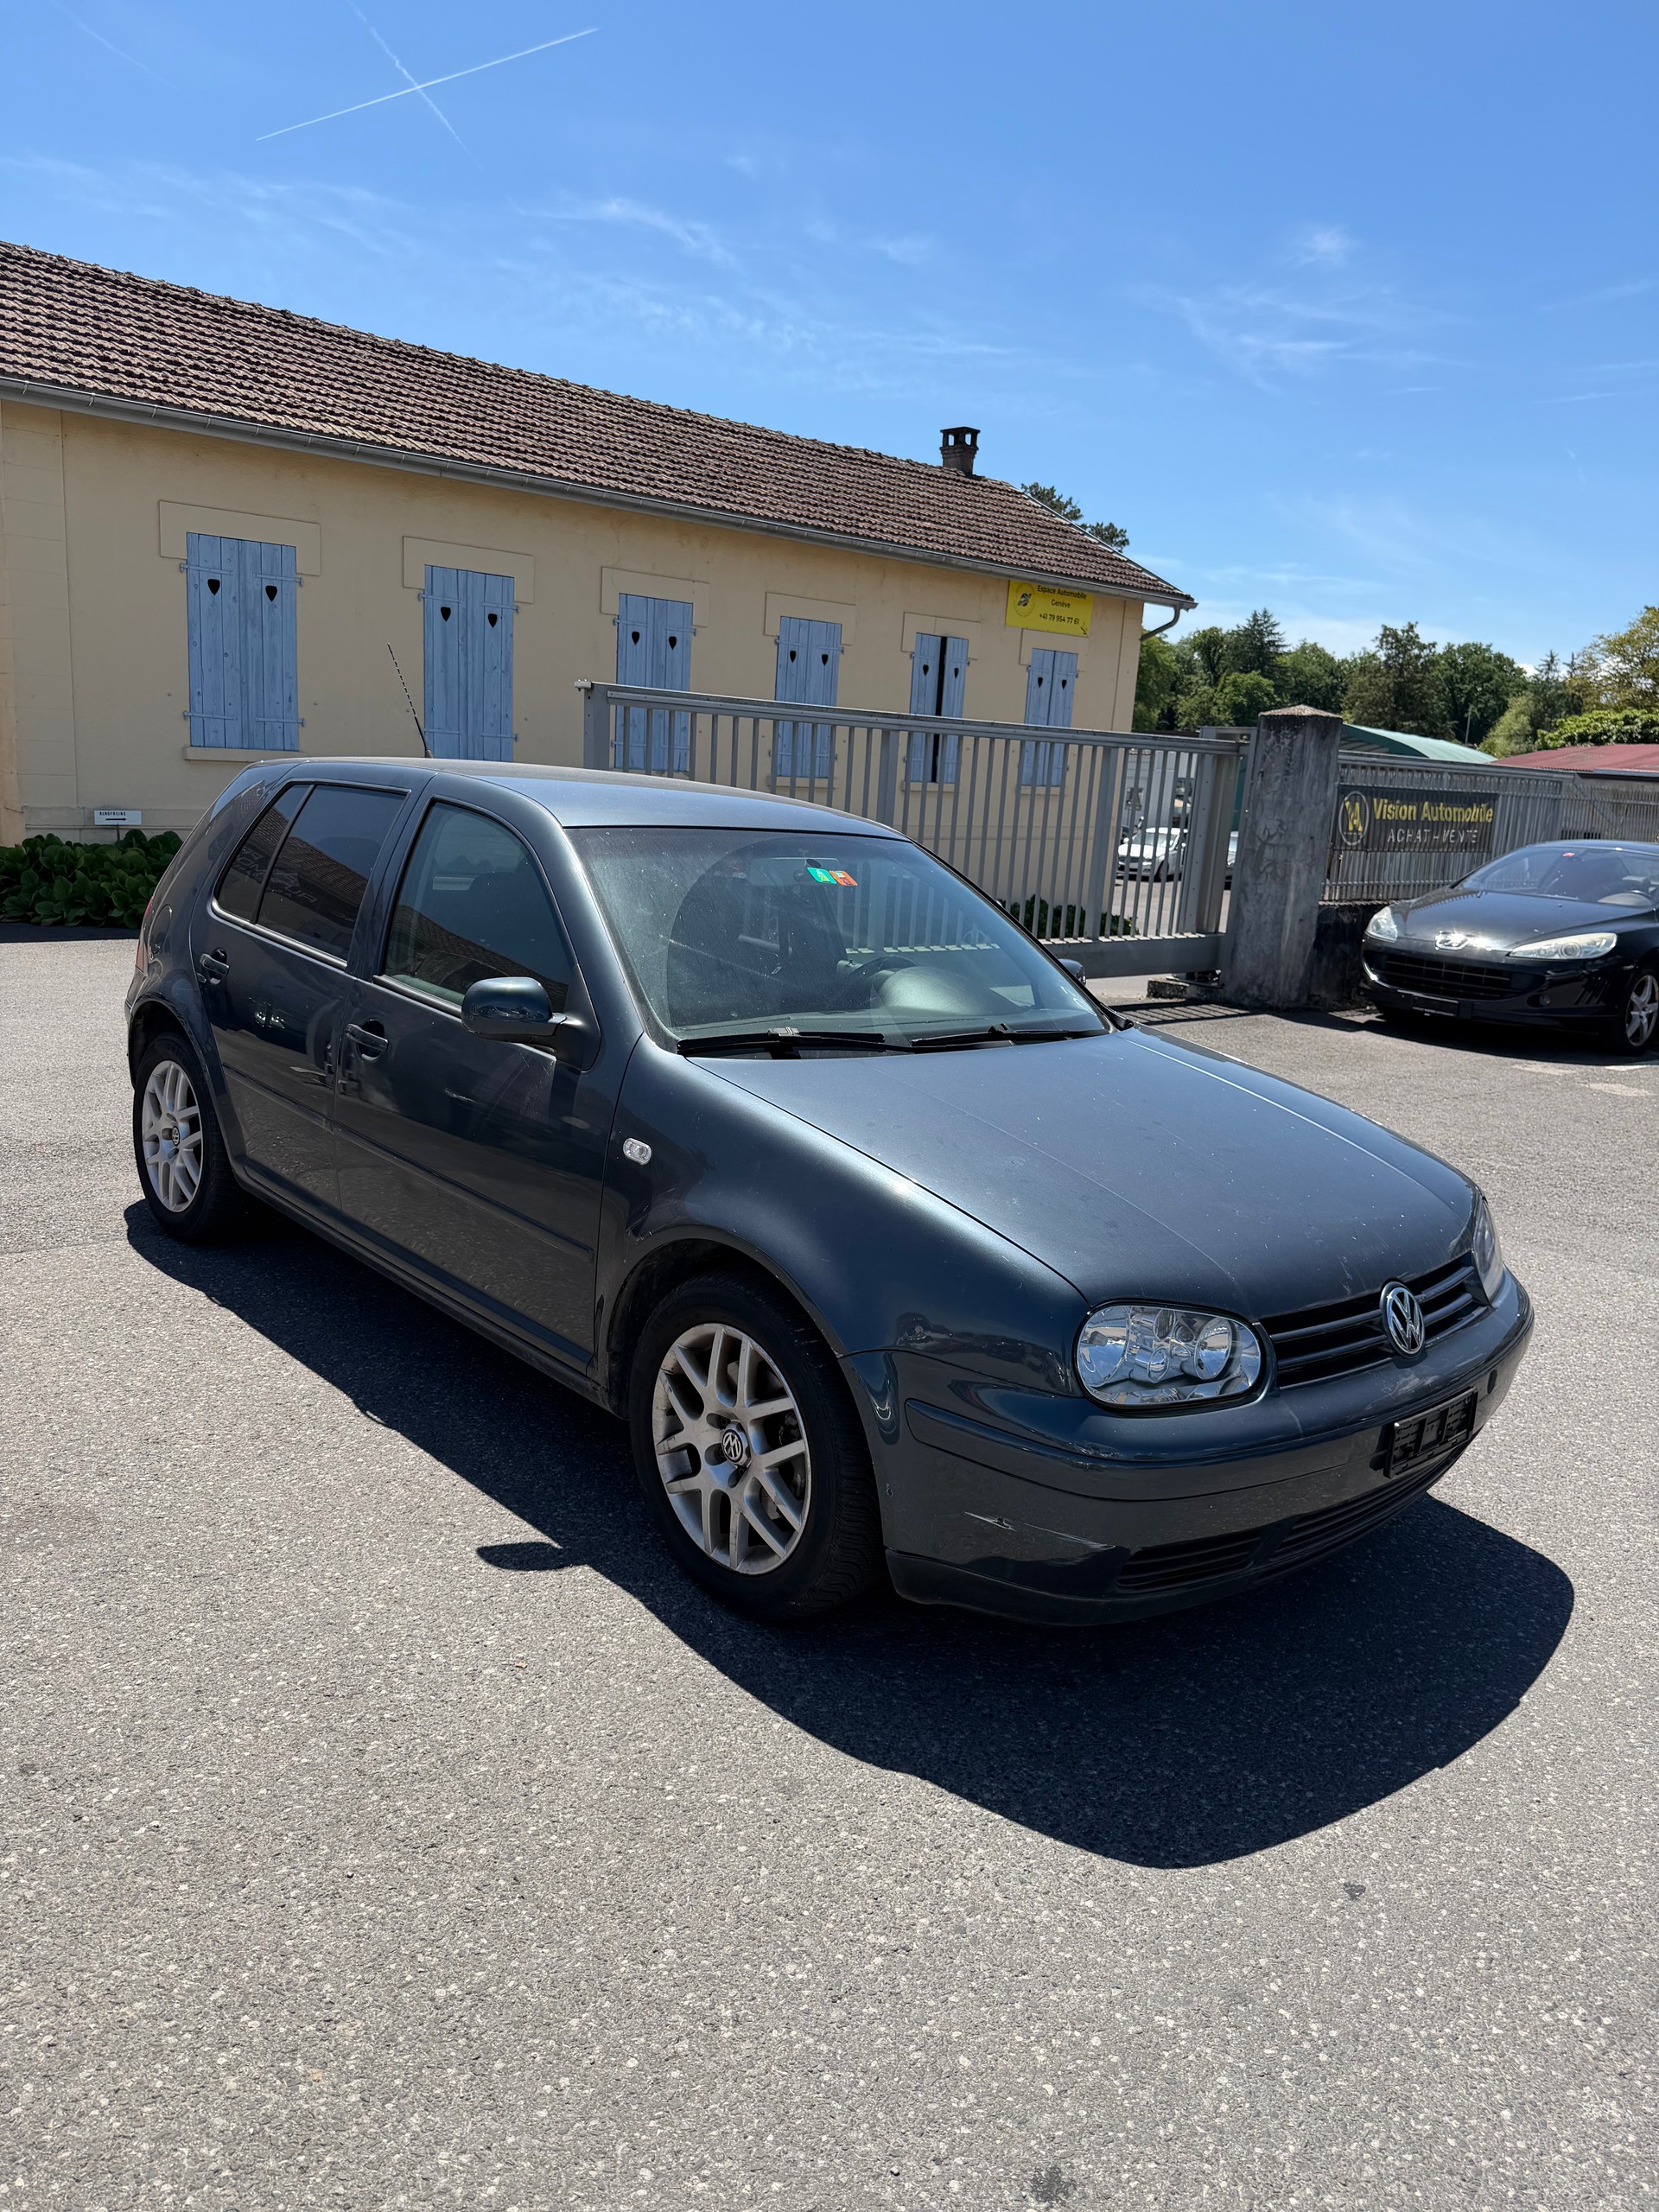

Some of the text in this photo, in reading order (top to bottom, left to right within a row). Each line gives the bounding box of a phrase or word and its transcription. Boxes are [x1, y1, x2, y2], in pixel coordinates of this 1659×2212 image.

[1037, 584, 1087, 600] Espace Automobile
[1373, 798, 1494, 823] Vision Automobile
[1387, 828, 1431, 843] ACHAT
